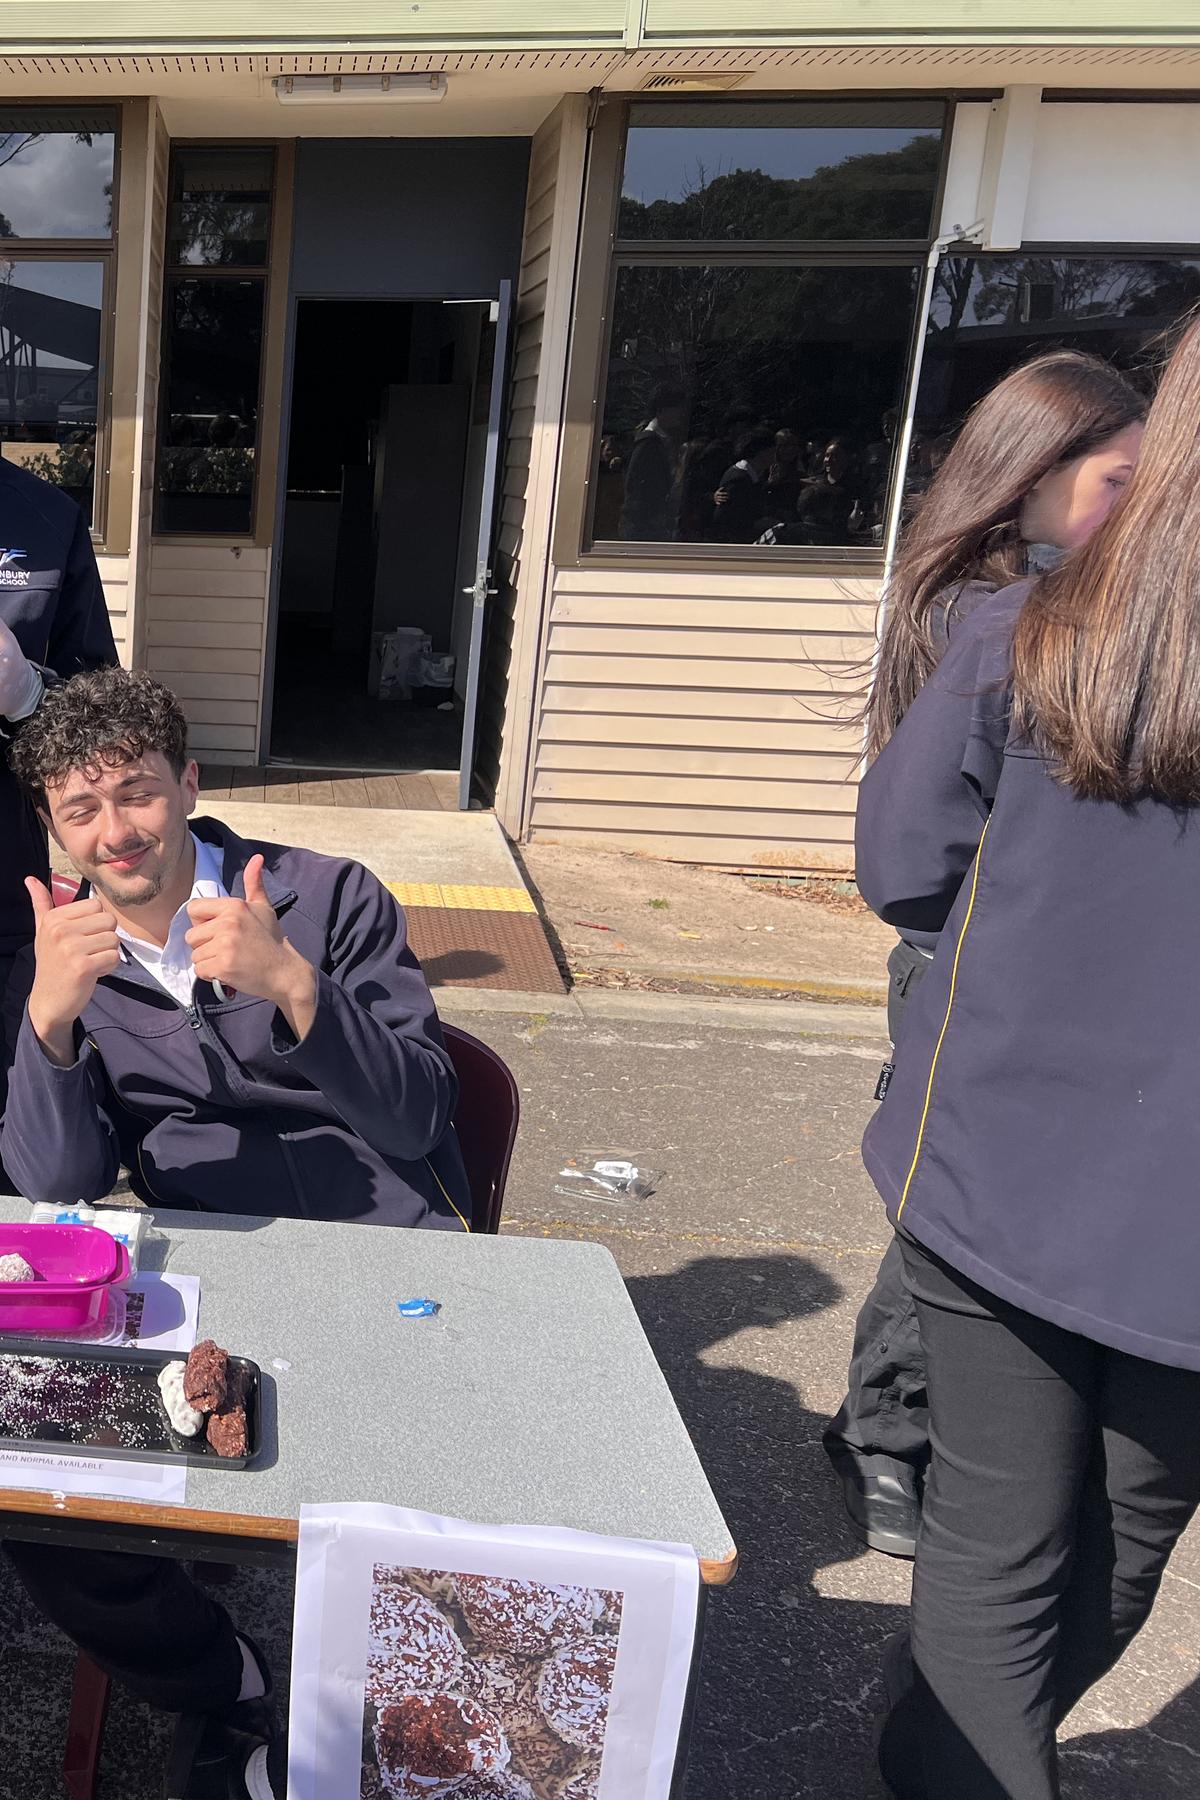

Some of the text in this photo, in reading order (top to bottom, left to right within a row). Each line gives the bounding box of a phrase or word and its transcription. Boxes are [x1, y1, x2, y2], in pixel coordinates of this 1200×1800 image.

[0, 1453, 18, 1462] AND
[20, 1455, 56, 1466] NORMAL
[57, 1459, 104, 1470] AVAILABLE
